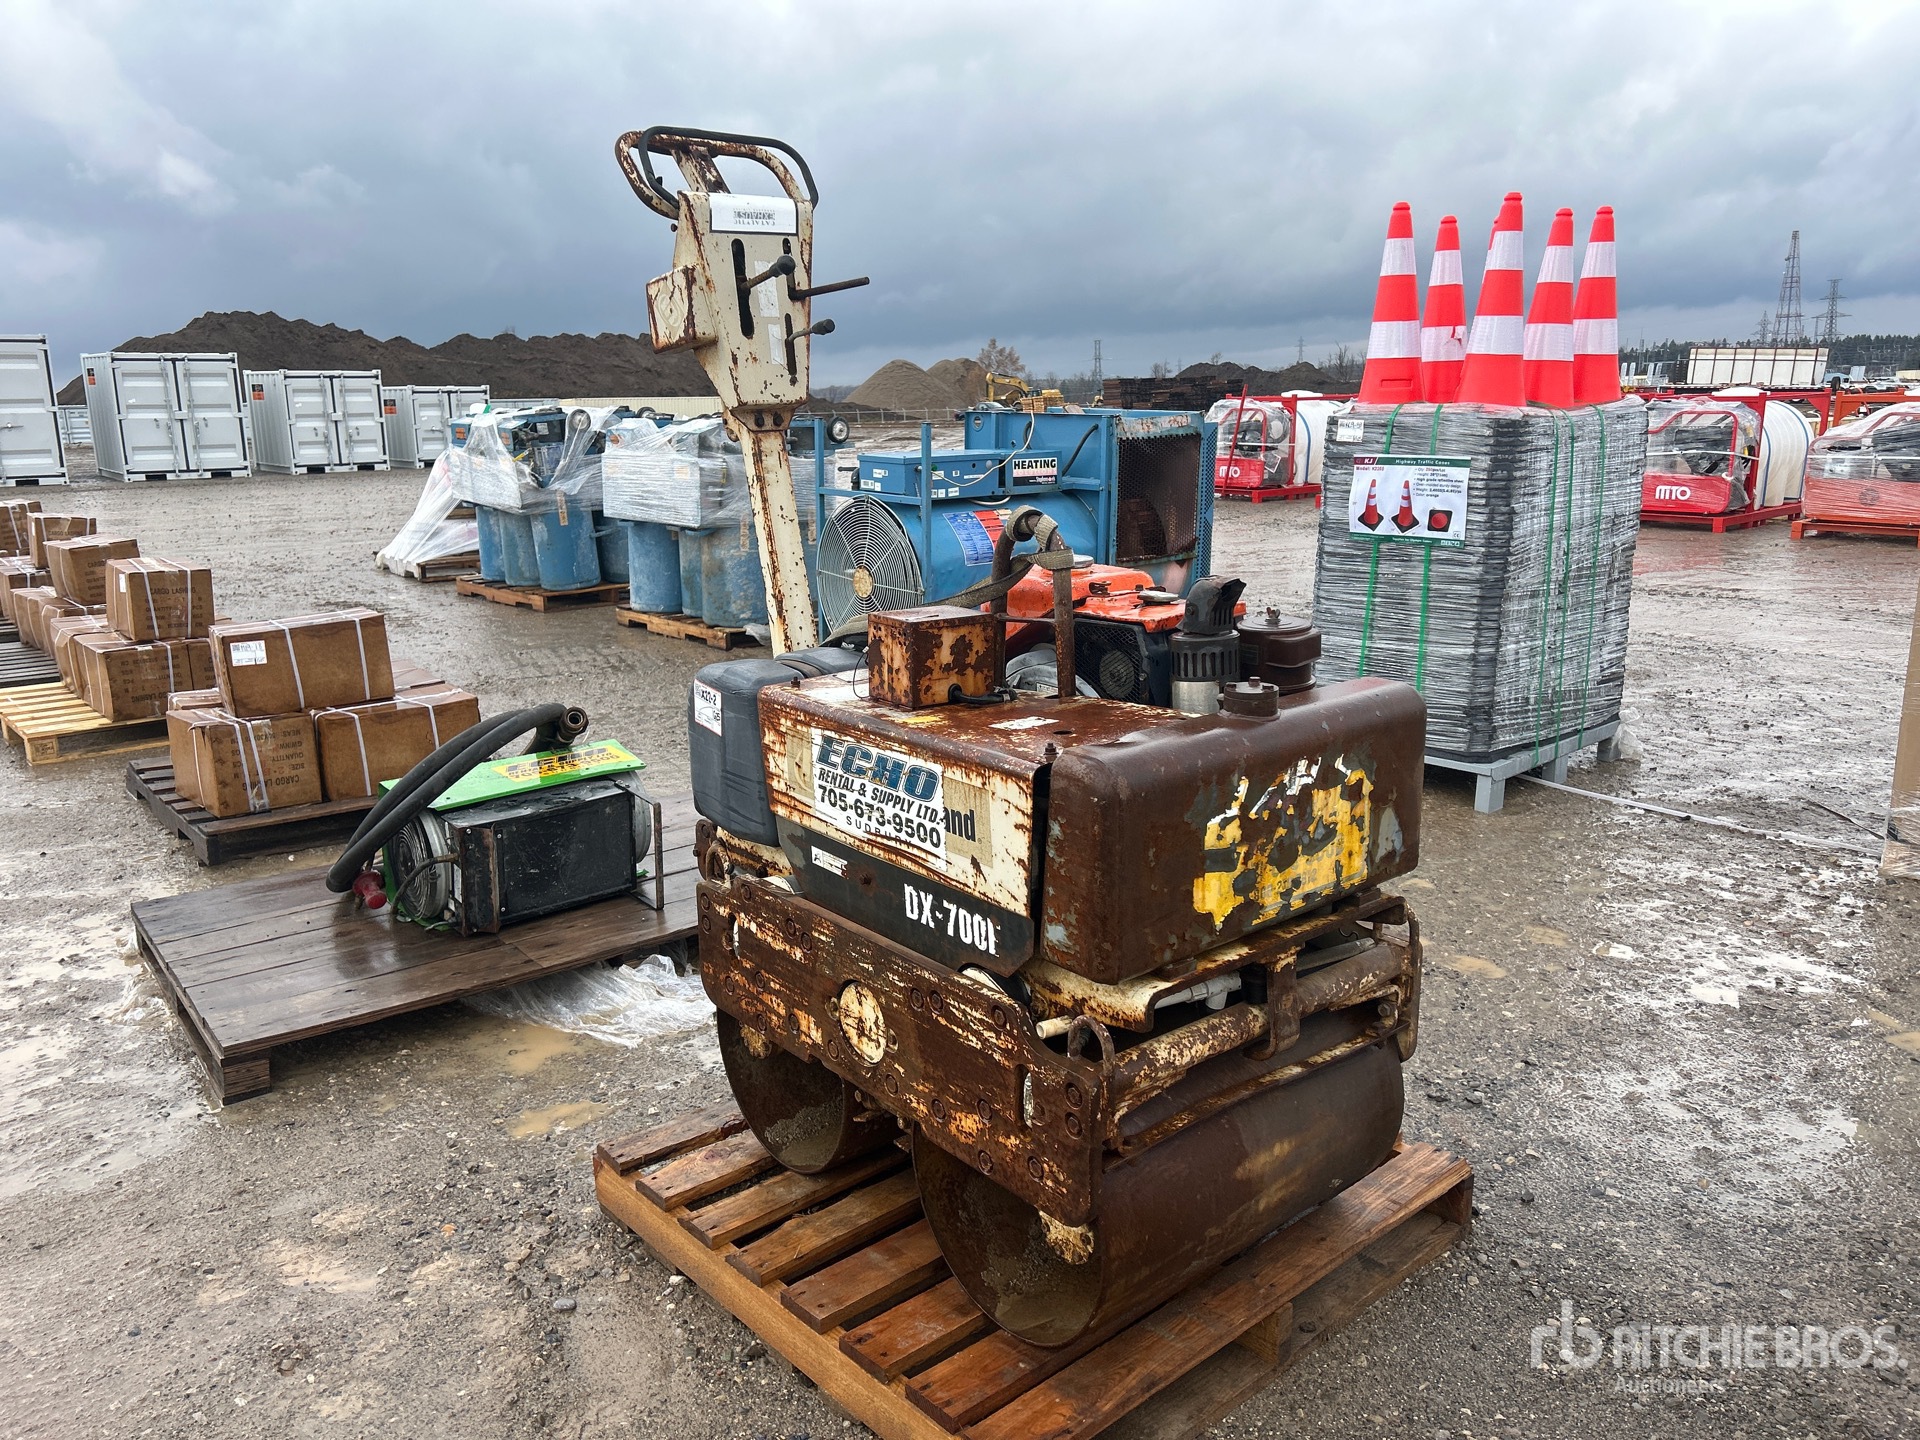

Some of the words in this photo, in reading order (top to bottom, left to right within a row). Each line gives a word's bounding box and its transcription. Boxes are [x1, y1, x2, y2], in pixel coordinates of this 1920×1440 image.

[1013, 458, 1056, 470] HEATING
[275, 774, 300, 786] CARGO
[815, 733, 940, 803] ECHO
[817, 784, 942, 849] 705-673-9500
[818, 767, 855, 794] RENTAL
[857, 782, 867, 798] &
[870, 787, 916, 815] SUPPLY
[915, 803, 942, 826] LTD.
[845, 815, 912, 850] SUDBURY
